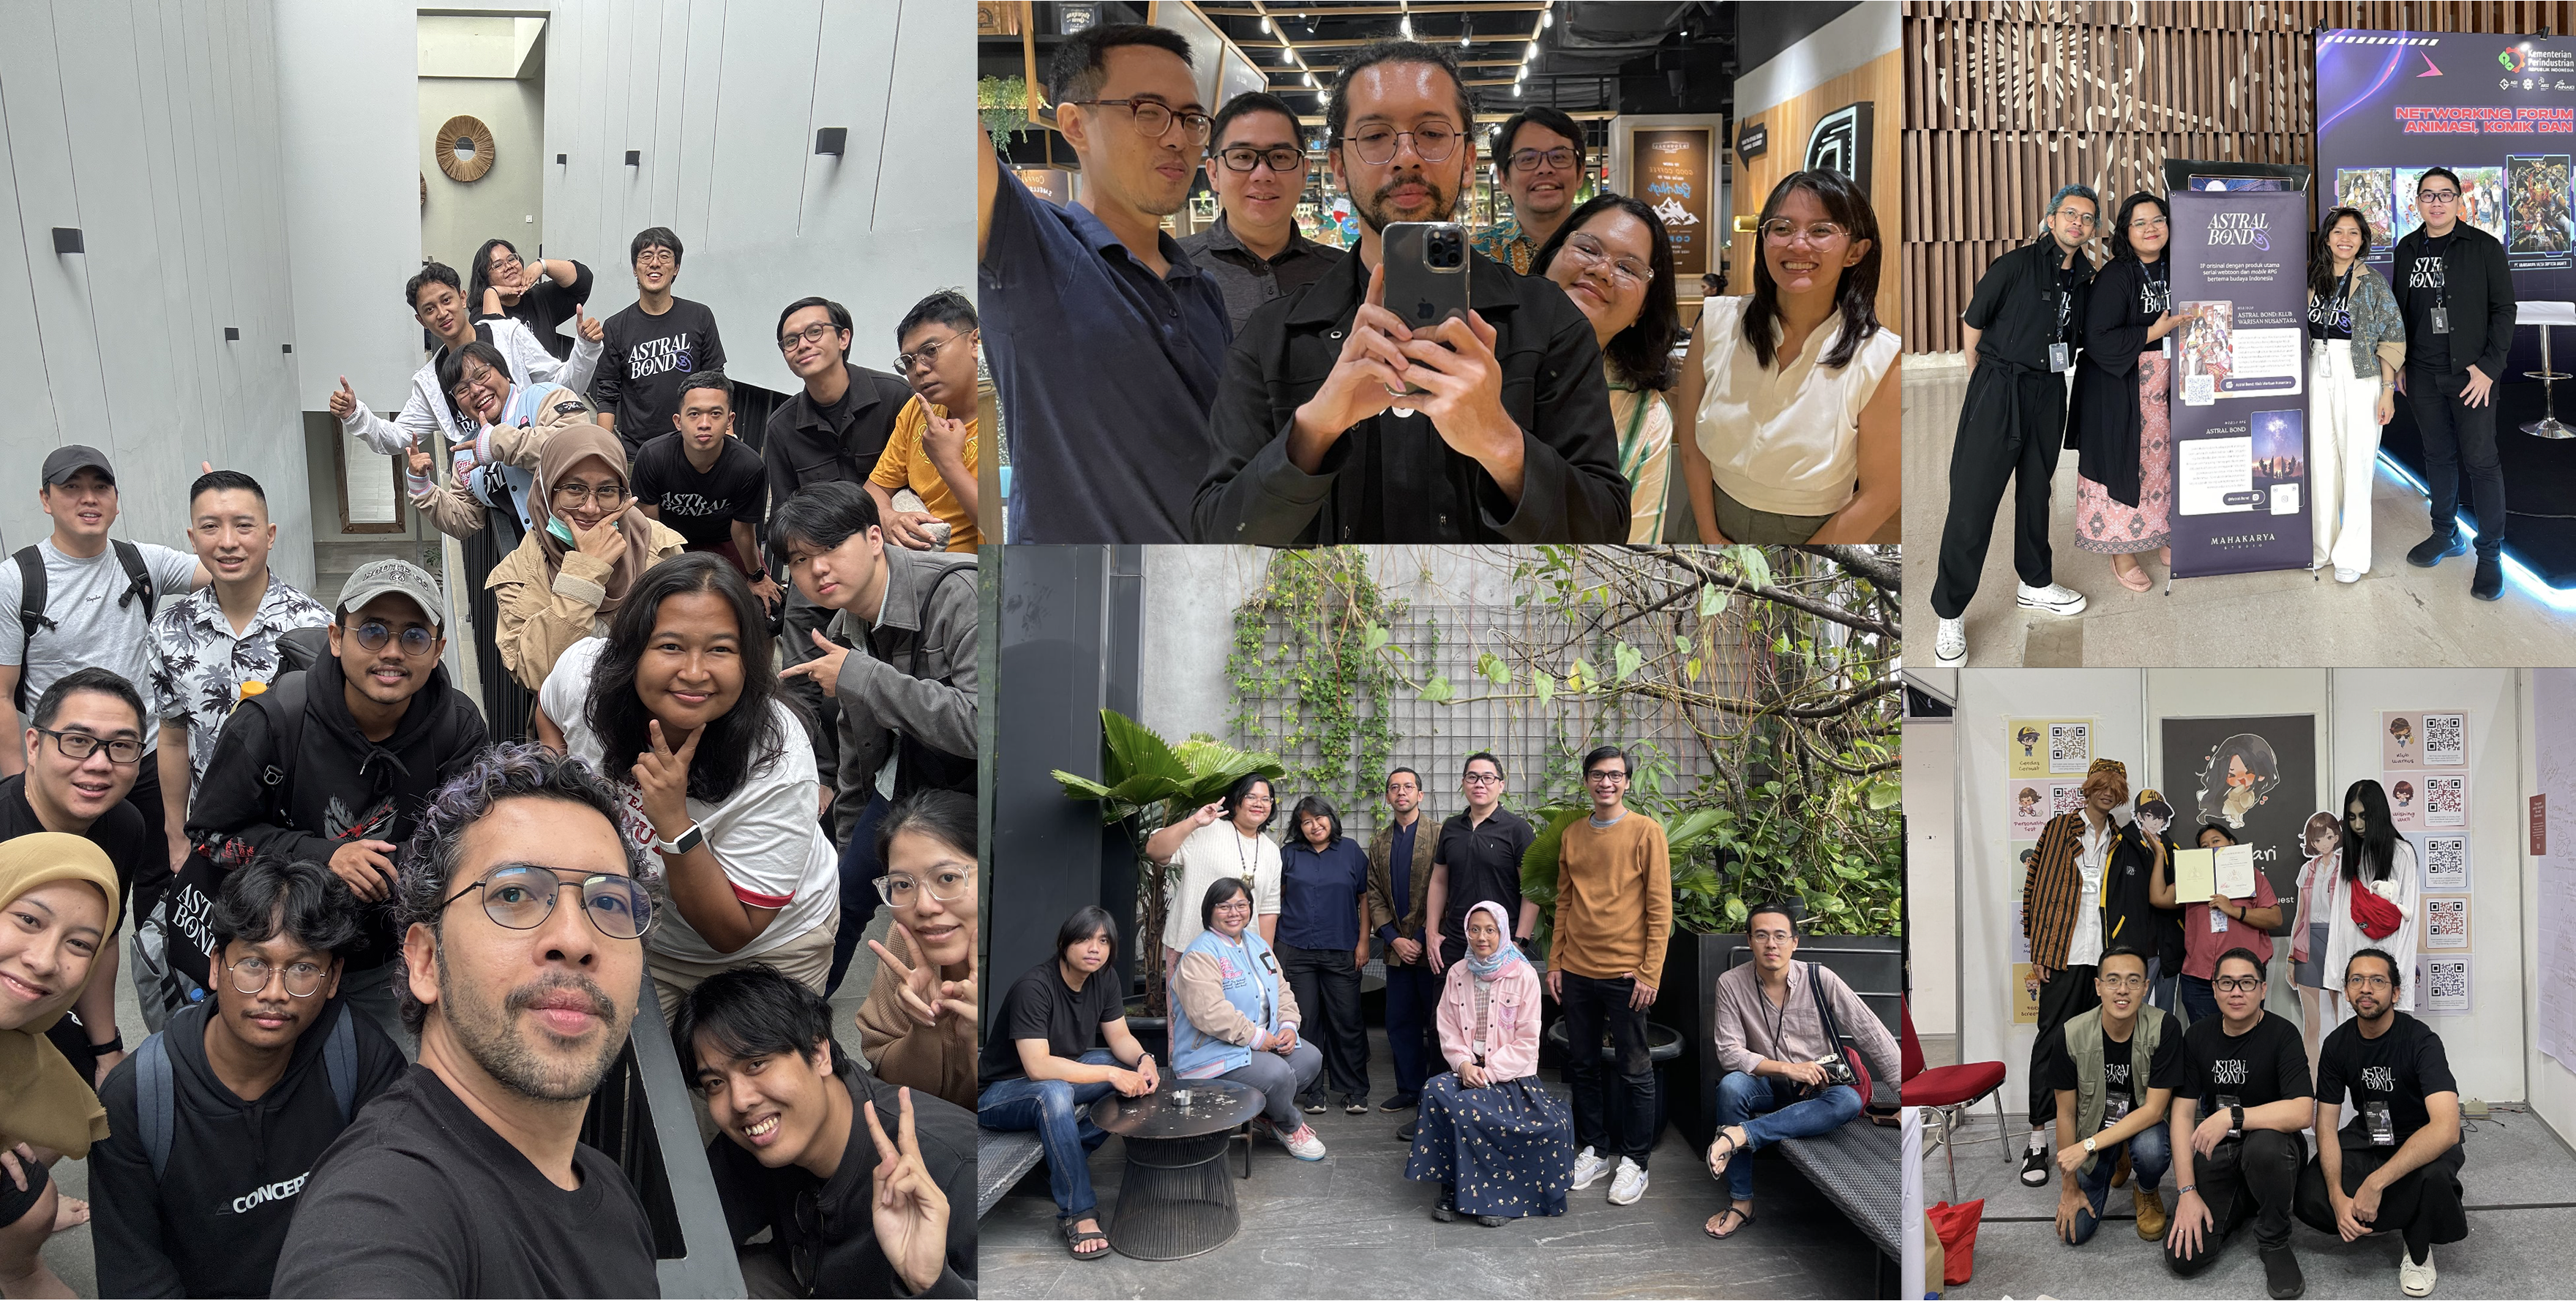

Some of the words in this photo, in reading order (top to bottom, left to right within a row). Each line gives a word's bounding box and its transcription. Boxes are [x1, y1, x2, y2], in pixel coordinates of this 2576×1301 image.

[2528, 49, 2572, 59] Kementerian
[2528, 58, 2575, 67] Perindustrian
[2395, 107, 2512, 119] NETWORKING
[2516, 108, 2573, 119] FORUM
[2404, 121, 2479, 134] ANIMASI,
[2483, 121, 2535, 132] KOMIK
[2538, 121, 2573, 132] DAN
[2207, 213, 2269, 229] ASTRAL
[2207, 228, 2254, 245] BOND
[628, 332, 691, 364] ASTRAL
[631, 353, 678, 380] BOND
[661, 499, 713, 517] BOND
[2210, 533, 2275, 545] MAHAKARYA
[362, 563, 411, 582] ROUTE
[413, 574, 429, 591] 66
[2214, 1071, 2245, 1084] BOND
